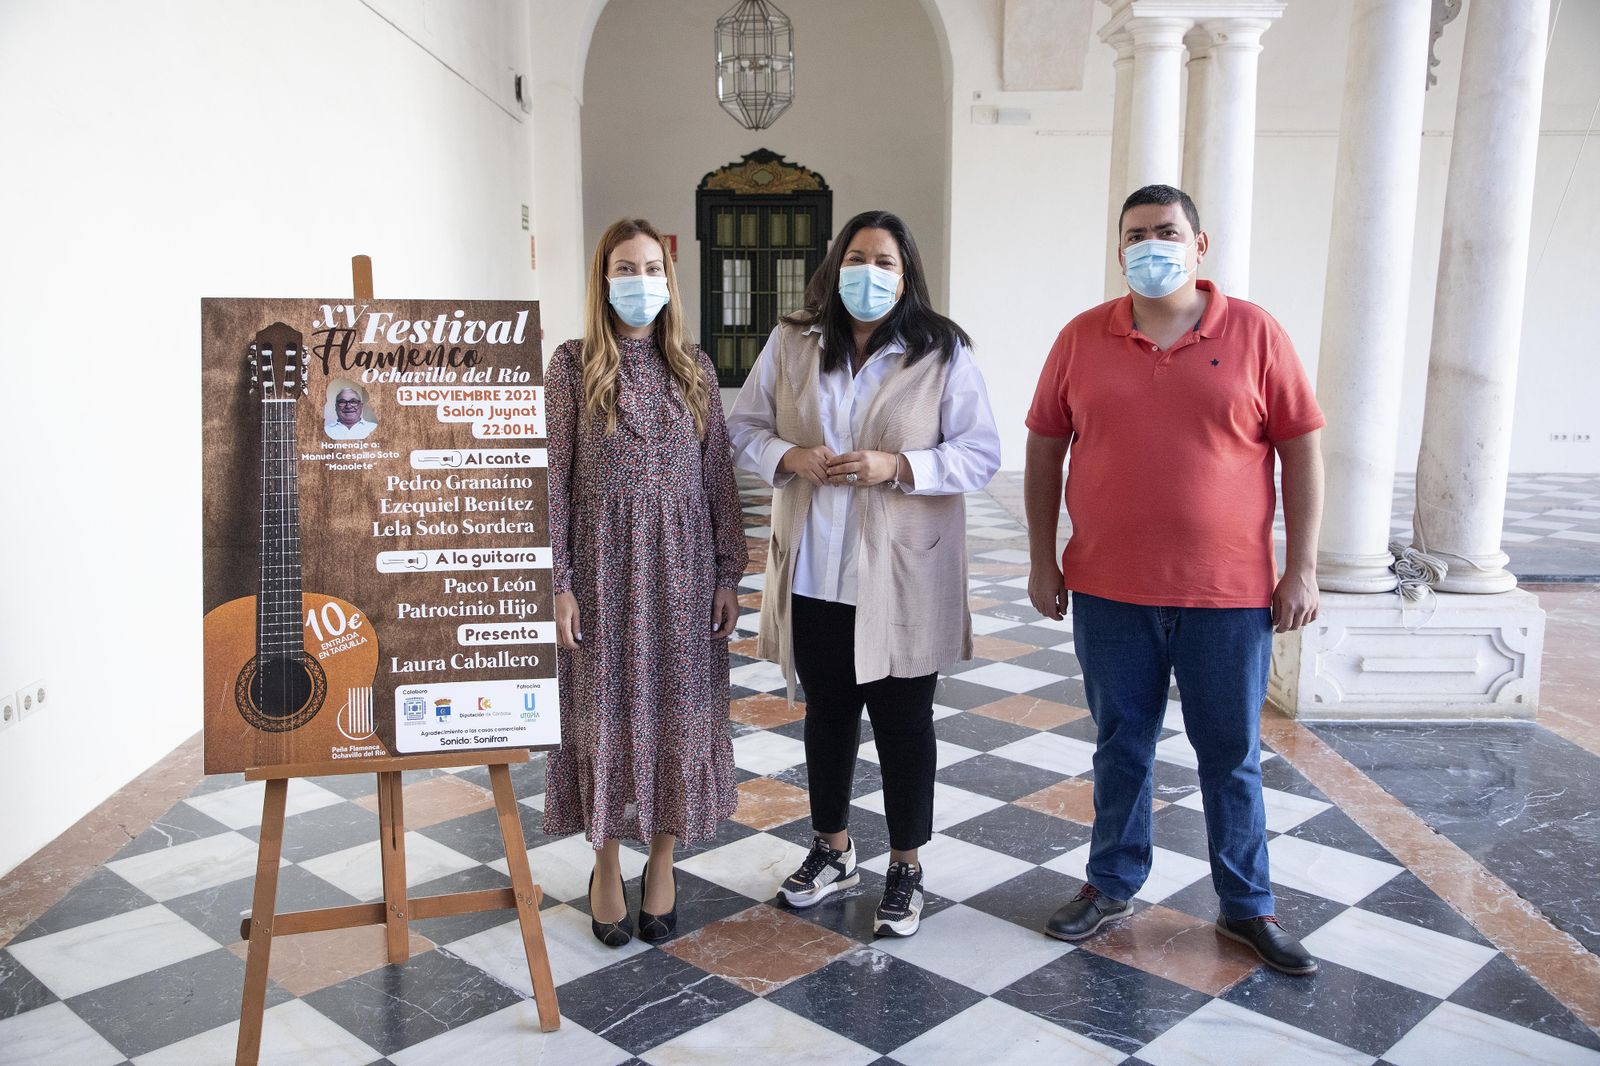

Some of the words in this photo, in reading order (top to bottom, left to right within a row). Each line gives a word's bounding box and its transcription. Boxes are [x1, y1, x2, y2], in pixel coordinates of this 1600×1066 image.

[360, 310, 529, 345] Festival
[312, 327, 483, 376] Flamenco
[362, 367, 456, 384] Ochavillo
[462, 367, 491, 383] del
[497, 366, 530, 383] Río
[399, 390, 412, 401] 13
[417, 390, 501, 401] NOVIEMBRE
[504, 390, 537, 401] 2021
[443, 405, 483, 417] Salón
[488, 406, 537, 420] Juynat
[482, 424, 521, 435] 22:00
[524, 424, 538, 435] H.
[321, 442, 368, 450] Homenaje
[336, 452, 375, 462] Crespillo
[465, 453, 482, 465] Al
[486, 453, 531, 465] cante
[387, 475, 441, 491] Pedro
[446, 474, 532, 489] Granaíno
[380, 498, 458, 517] Ezequiel
[465, 496, 534, 512] Benítez
[372, 521, 412, 537] Lela
[416, 520, 458, 536] Soto
[462, 519, 534, 534] Sordera
[436, 553, 448, 565] A
[453, 552, 467, 564] la
[472, 550, 536, 567] guitarra
[444, 578, 488, 594] Paco
[493, 576, 536, 592] León
[398, 601, 495, 618] Patrocinio
[500, 599, 538, 620] Hijo
[305, 601, 363, 641] 10€
[321, 631, 360, 650] ENTRADA
[465, 628, 538, 641] Presenta
[319, 650, 330, 660] EN
[330, 636, 368, 656] TAQUILLA
[392, 655, 446, 673] Laura
[451, 652, 539, 670] Caballero
[440, 737, 472, 746] Sonido:
[474, 735, 508, 744] Sonifran
